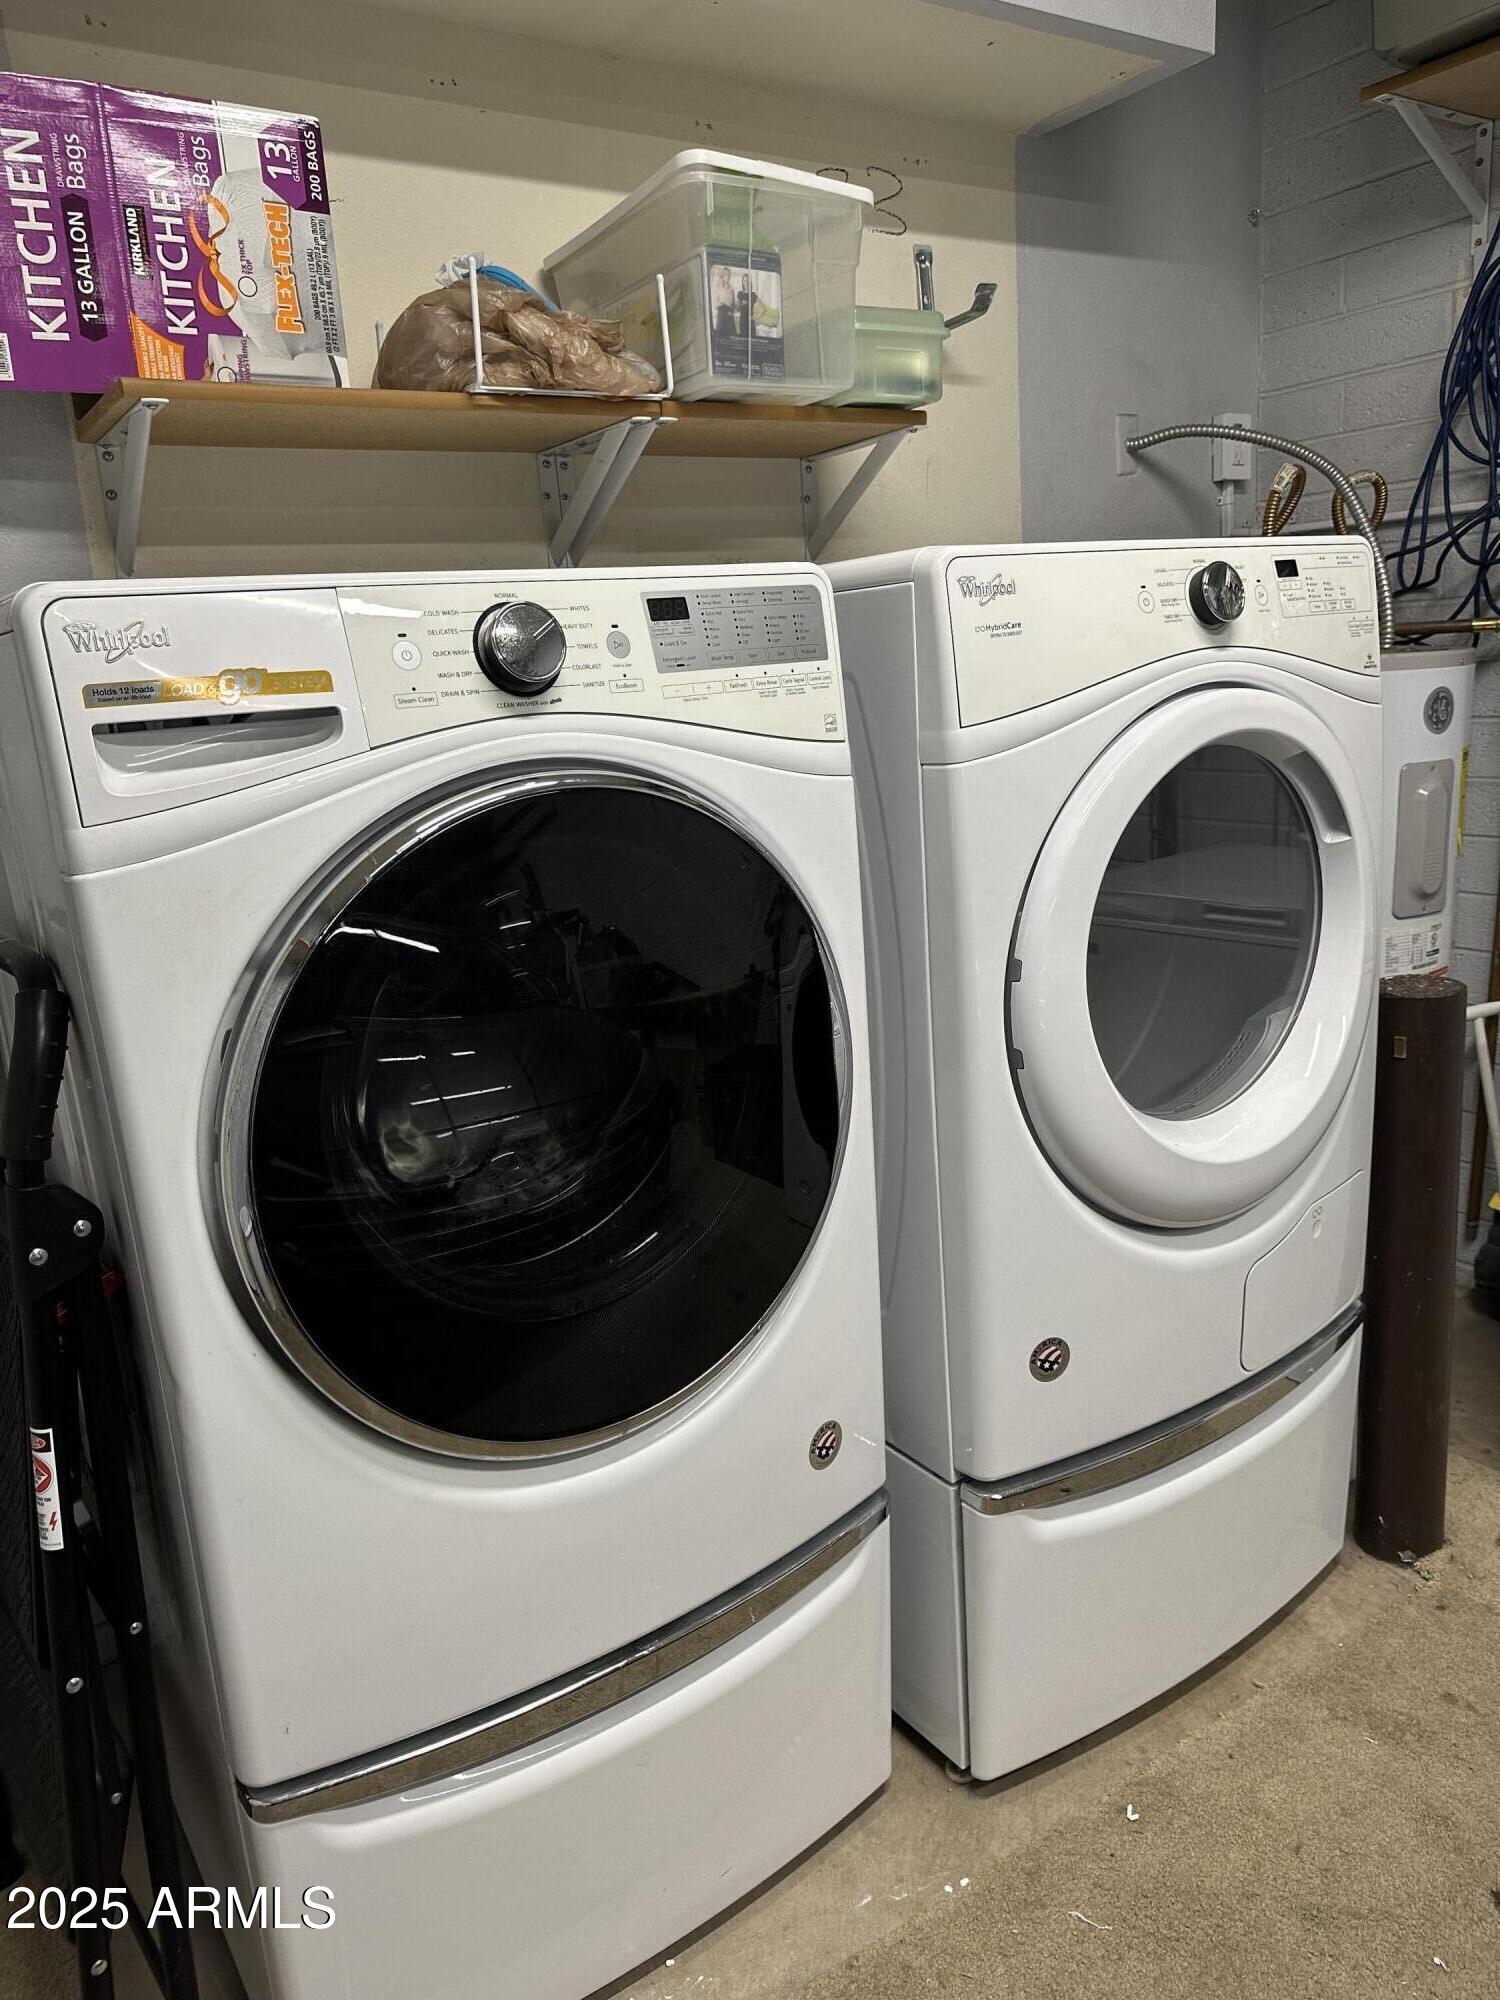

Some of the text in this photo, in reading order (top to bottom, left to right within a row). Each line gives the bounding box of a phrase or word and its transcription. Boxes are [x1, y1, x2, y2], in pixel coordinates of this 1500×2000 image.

[50, 132, 65, 188] DRAWSTRING
[64, 133, 87, 190] Bags
[177, 131, 191, 187] DRAWSTRING
[190, 135, 212, 187] Bags
[264, 142, 293, 180] 13
[289, 145, 301, 182] GALLON
[303, 131, 323, 201] 200 BAGS
[1, 128, 71, 342] KITCHEN
[125, 207, 146, 276] KIRKLAND
[144, 156, 199, 336] KITCHEN
[238, 239, 246, 262] THICK
[69, 211, 99, 322] 13 GALLON
[263, 202, 305, 334] FLEX-TECH
[306, 247, 314, 263] GAL)
[311, 292, 320, 309] BAGS
[313, 309, 322, 321] 200
[142, 352, 151, 379] PANDABLE
[957, 574, 1017, 606] Whirlpool
[63, 621, 170, 663] Whirlpool
[427, 628, 459, 636] DELICATES
[986, 621, 1022, 633] HybridCare
[432, 650, 452, 658] QUICK
[92, 684, 155, 698] Holds 12 loads
[417, 696, 435, 704] Clean
[496, 701, 515, 709] CLEAN
[515, 700, 540, 708] WASHER
[1031, 1337, 1062, 1366] AMERICA
[810, 1421, 838, 1455] AMERICA
